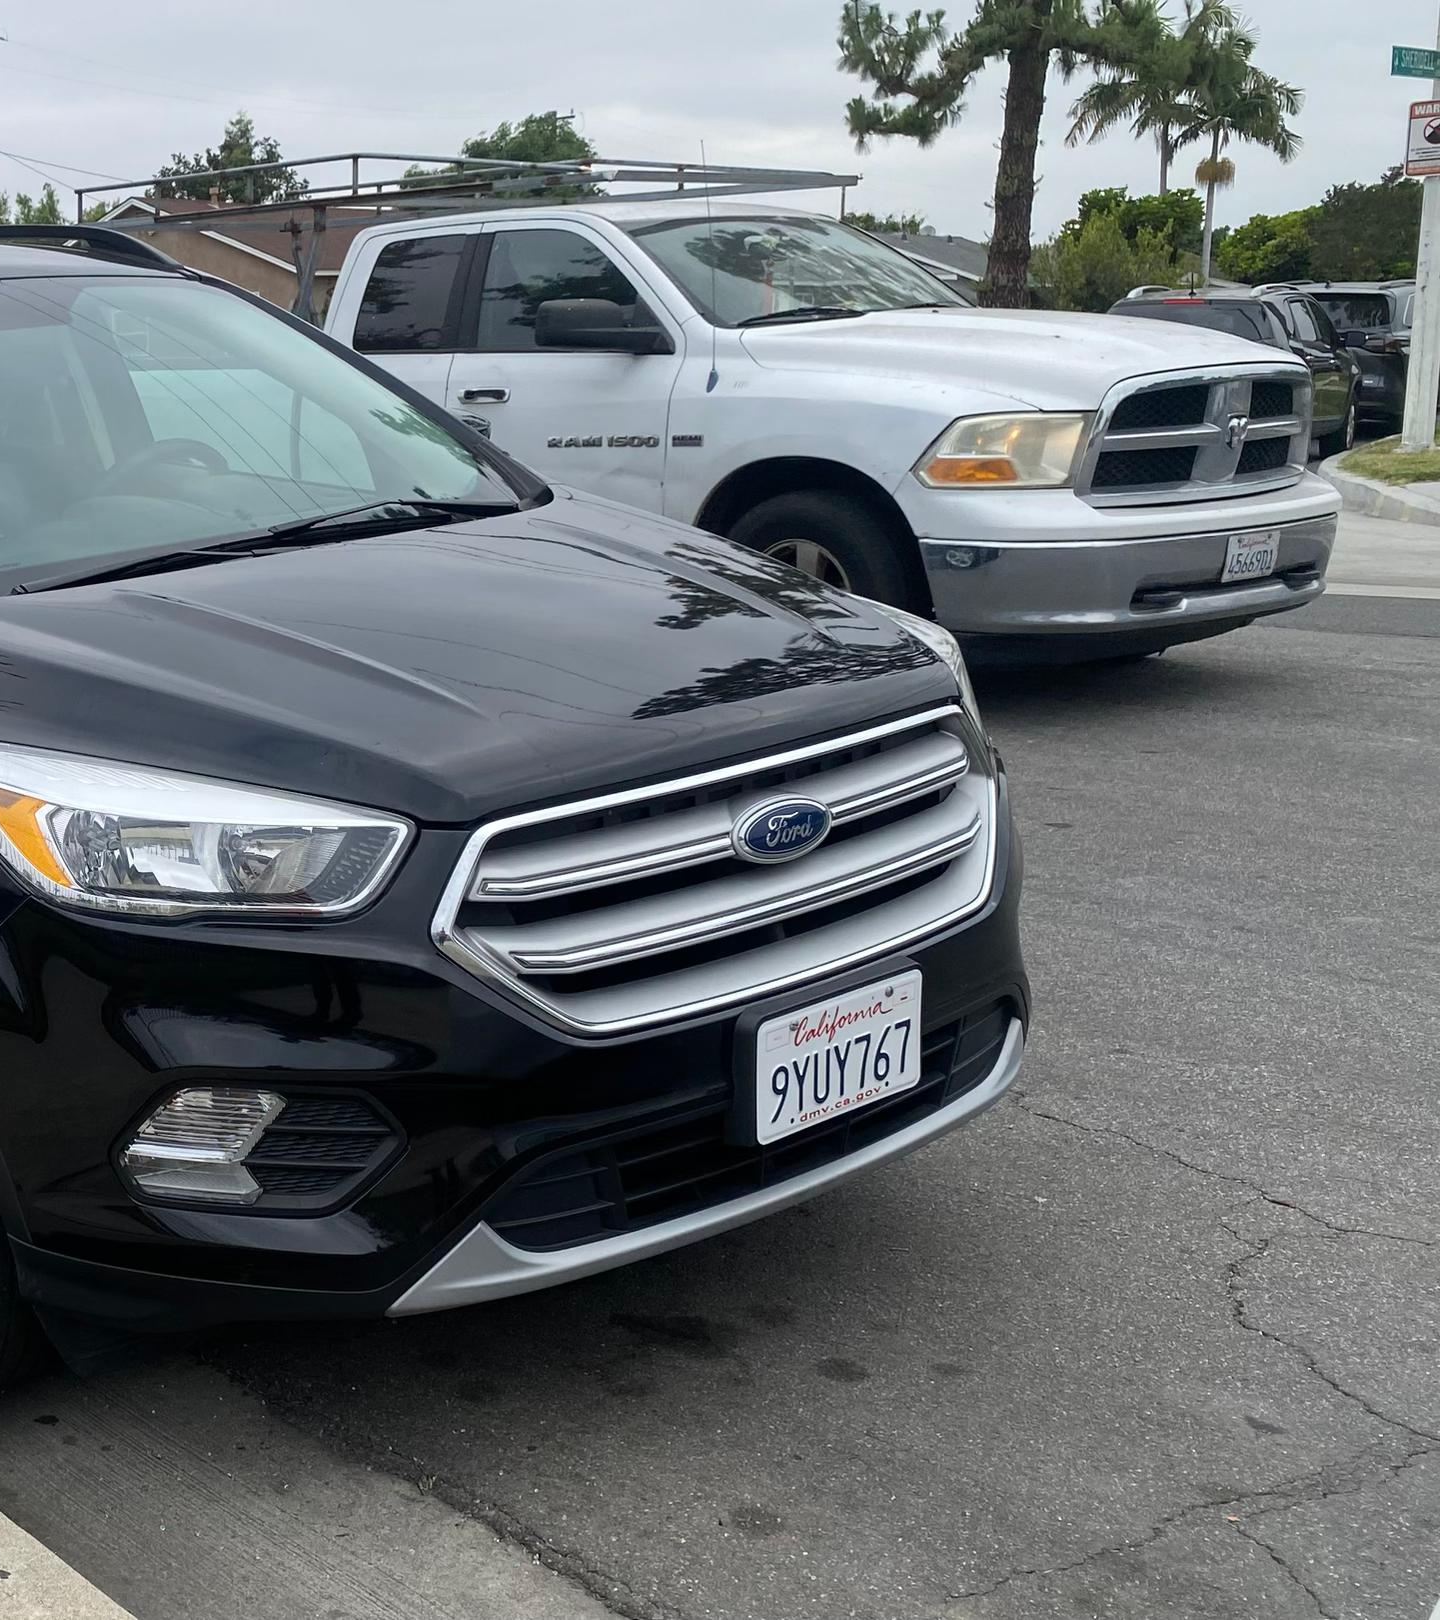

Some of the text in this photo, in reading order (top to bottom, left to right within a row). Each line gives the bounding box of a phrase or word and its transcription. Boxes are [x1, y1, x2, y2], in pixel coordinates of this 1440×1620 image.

[547, 435, 603, 448] RAM
[607, 435, 660, 448] 1500
[766, 811, 813, 847] Ford
[794, 1001, 893, 1047] California
[771, 1018, 911, 1124] 9YUY767
[800, 1085, 882, 1123] dmv.ca.gov
